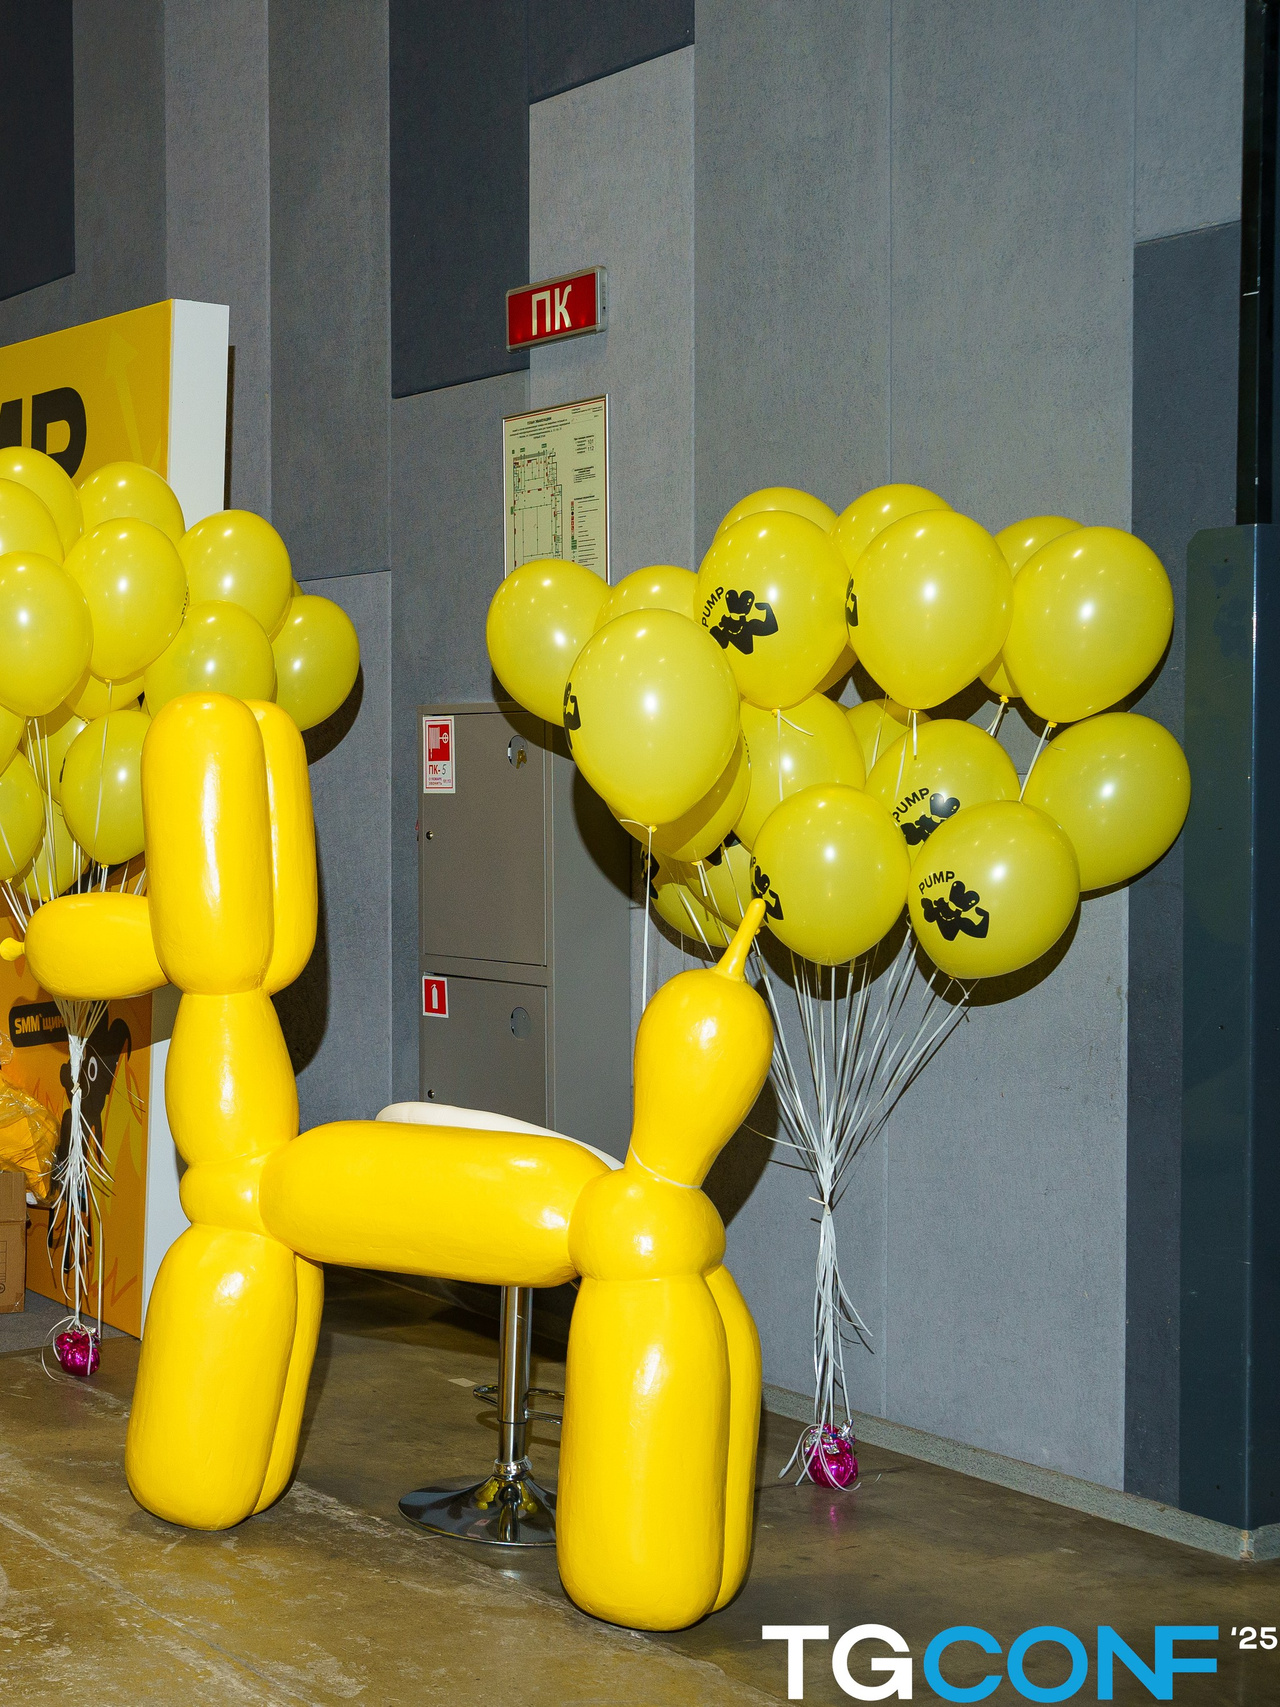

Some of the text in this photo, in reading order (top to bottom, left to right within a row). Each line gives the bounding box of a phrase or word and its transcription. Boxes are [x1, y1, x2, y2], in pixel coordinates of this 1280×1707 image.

[531, 284, 572, 336] ПК
[702, 586, 725, 628] PUMP
[892, 787, 930, 823] PUMP
[918, 870, 956, 895] PUMP
